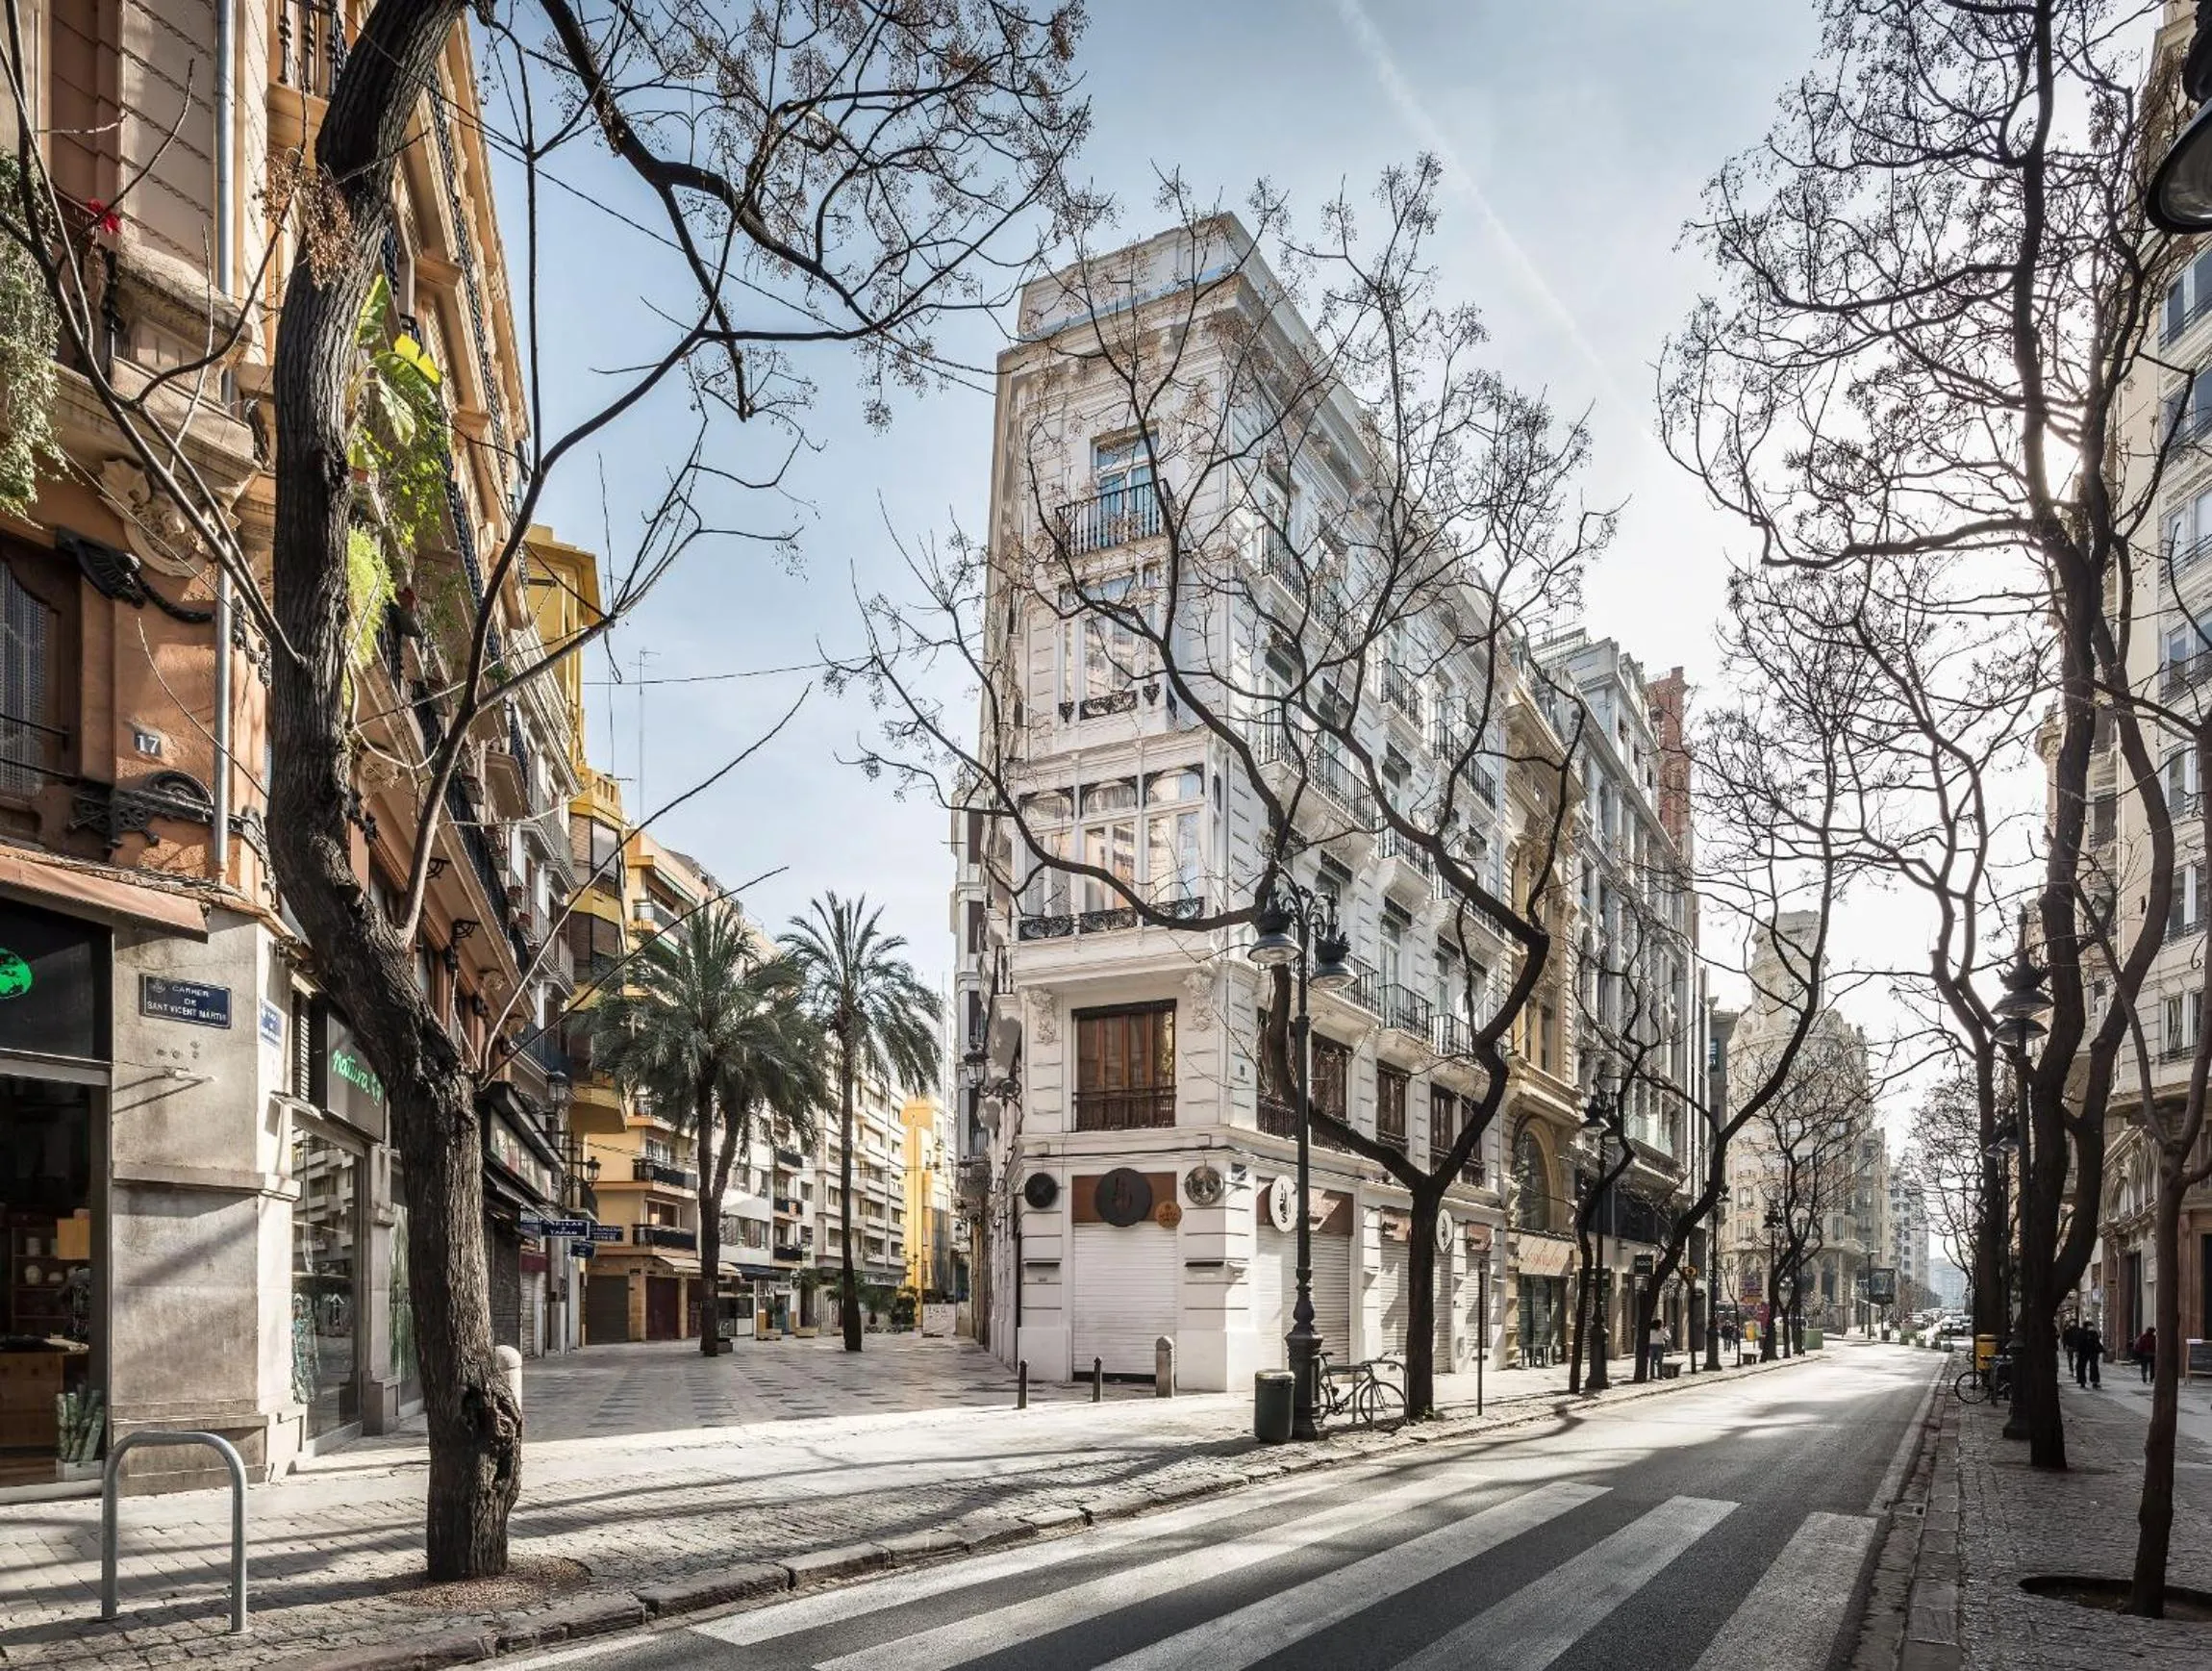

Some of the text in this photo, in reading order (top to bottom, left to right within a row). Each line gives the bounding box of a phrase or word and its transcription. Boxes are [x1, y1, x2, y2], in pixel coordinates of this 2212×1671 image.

[138, 735, 160, 753] 17
[171, 984, 210, 998] CARRER
[146, 1000, 168, 1012] SANT
[170, 1004, 197, 1017] VICENT
[183, 998, 197, 1006] DE
[333, 1049, 369, 1094] natura
